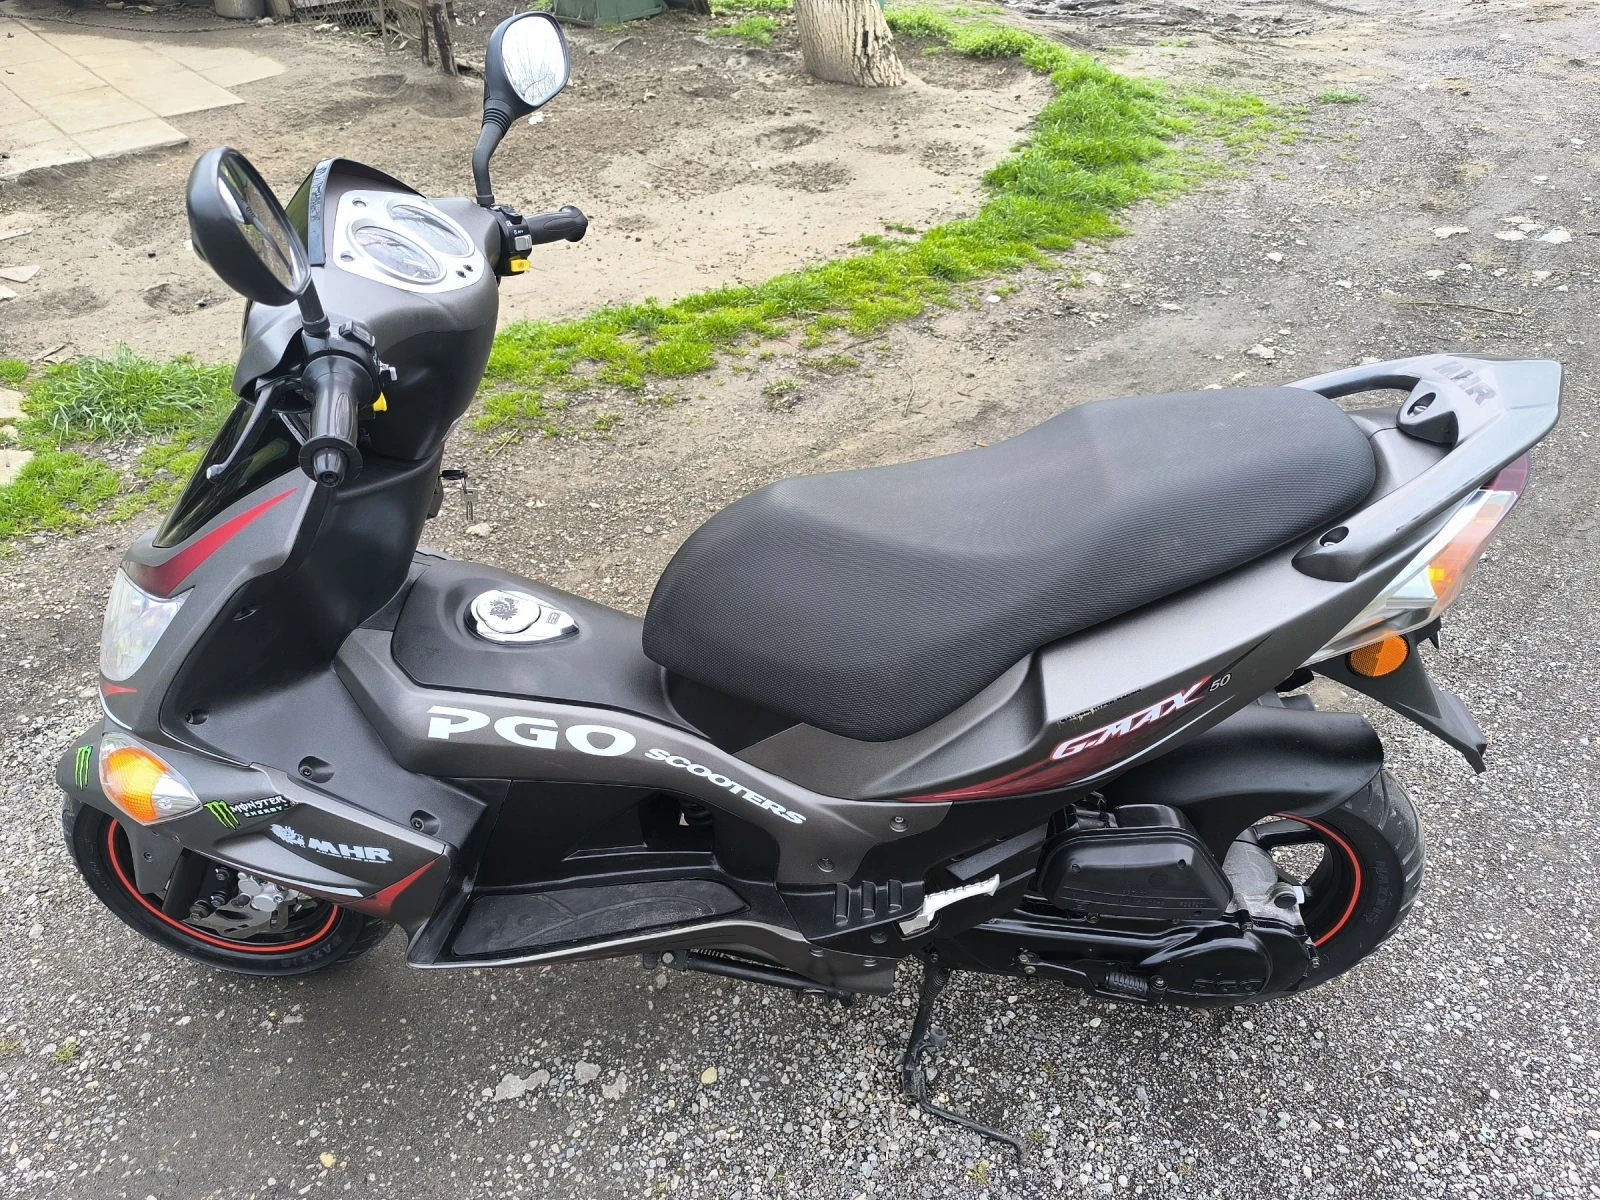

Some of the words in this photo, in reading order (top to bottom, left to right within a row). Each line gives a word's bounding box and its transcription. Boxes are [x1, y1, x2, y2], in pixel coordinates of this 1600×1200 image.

[1432, 361, 1497, 406] MHR
[1209, 673, 1232, 692] 50
[426, 705, 637, 757] PGO
[643, 748, 807, 825] SCOOTERS
[229, 795, 287, 814] MONSTER
[308, 837, 393, 862] MHR
